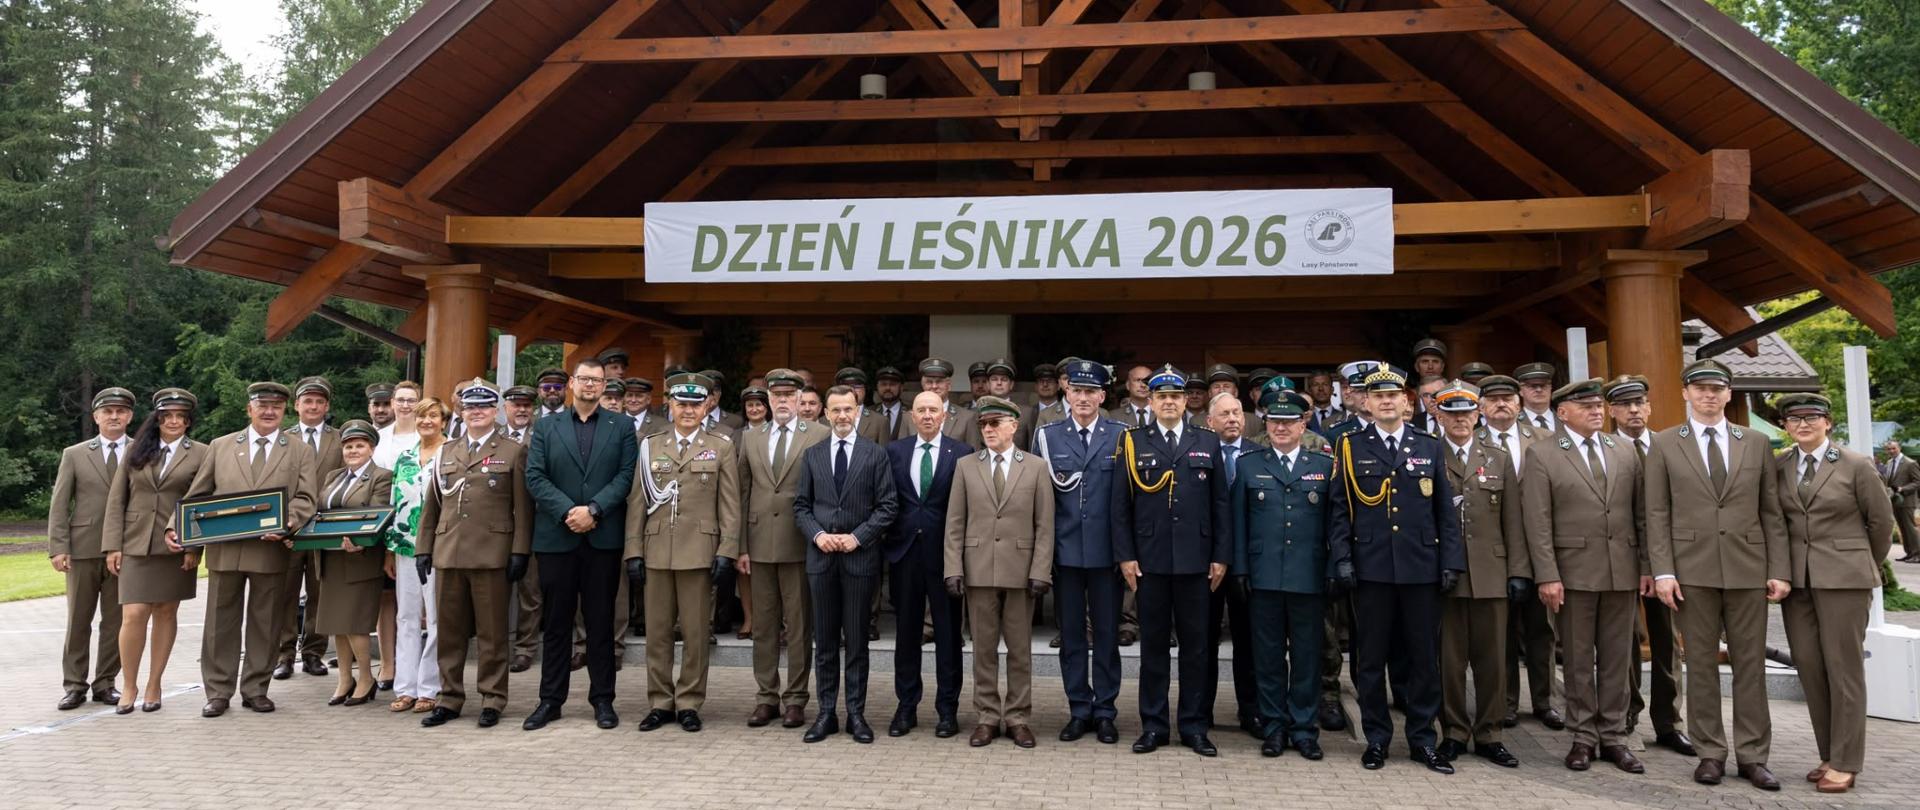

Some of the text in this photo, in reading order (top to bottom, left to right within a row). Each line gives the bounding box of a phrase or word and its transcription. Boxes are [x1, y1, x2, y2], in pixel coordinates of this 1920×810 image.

[691, 203, 1288, 273] DZIEŃ LEŚNIKA 2026
[1301, 262, 1317, 270] Lasy
